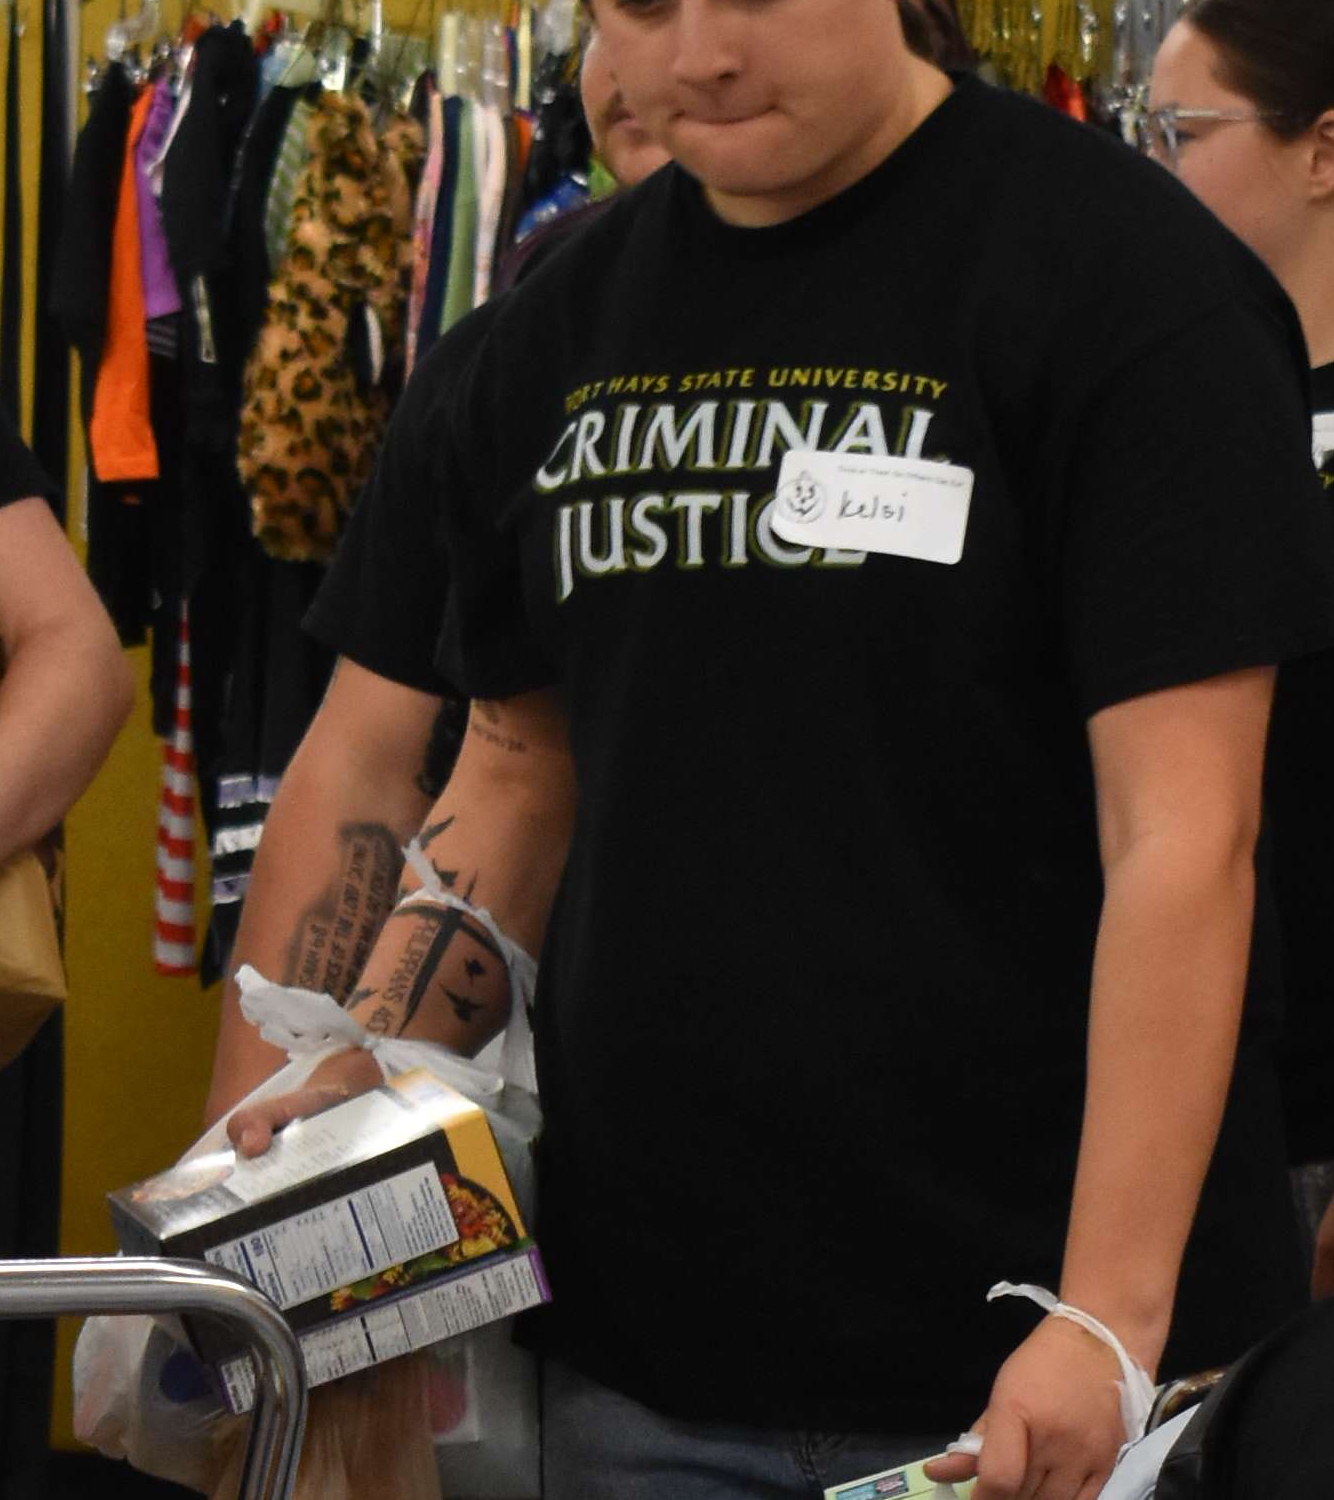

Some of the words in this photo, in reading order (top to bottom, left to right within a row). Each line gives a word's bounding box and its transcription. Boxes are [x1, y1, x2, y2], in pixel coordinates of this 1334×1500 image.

[606, 371, 671, 396] HAYS
[677, 367, 757, 393] STATE
[767, 365, 948, 400] UNIVERSITY
[534, 397, 955, 493] CRIMINAL
[556, 488, 869, 604] JUSTIC
